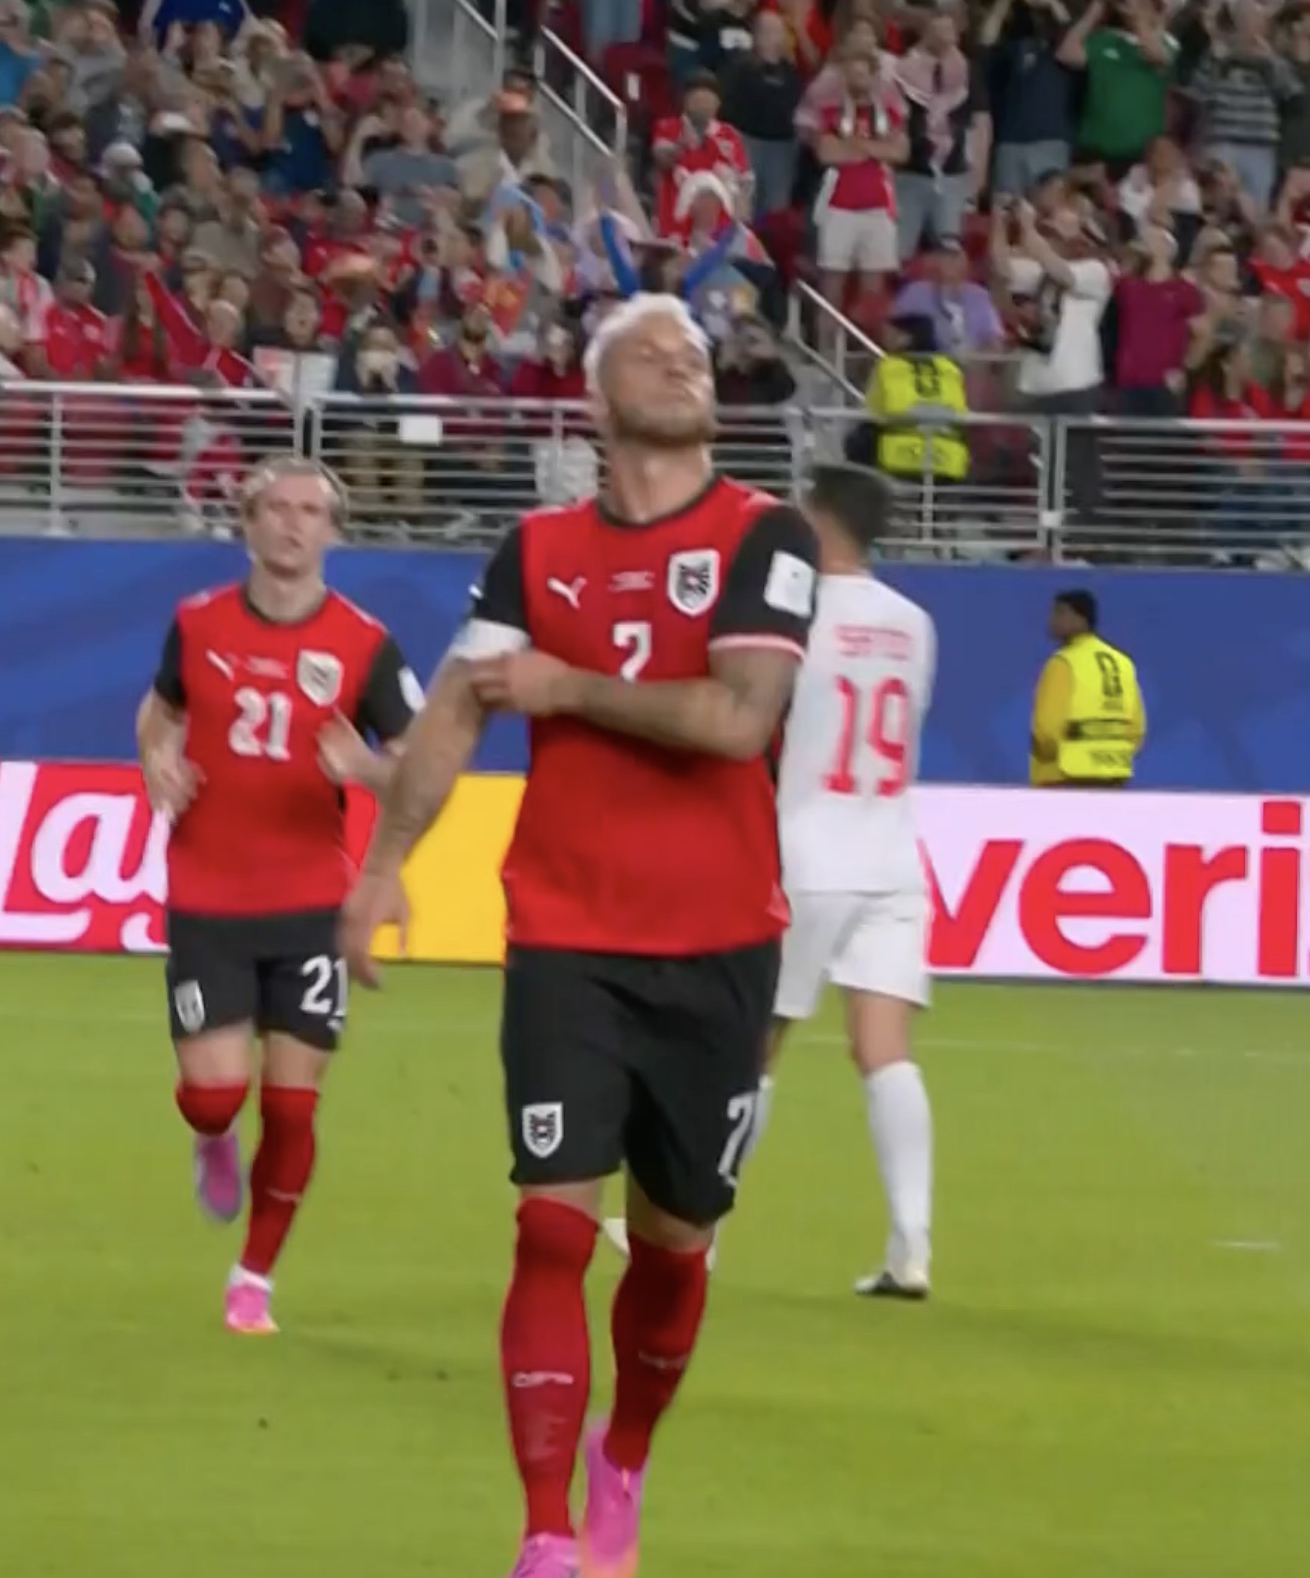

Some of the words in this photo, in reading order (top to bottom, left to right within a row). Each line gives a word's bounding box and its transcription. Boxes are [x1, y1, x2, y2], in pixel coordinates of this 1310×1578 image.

[228, 686, 293, 761] 21
[822, 674, 909, 799] 19
[916, 800, 1310, 978] veri
[298, 954, 348, 1016] 21
